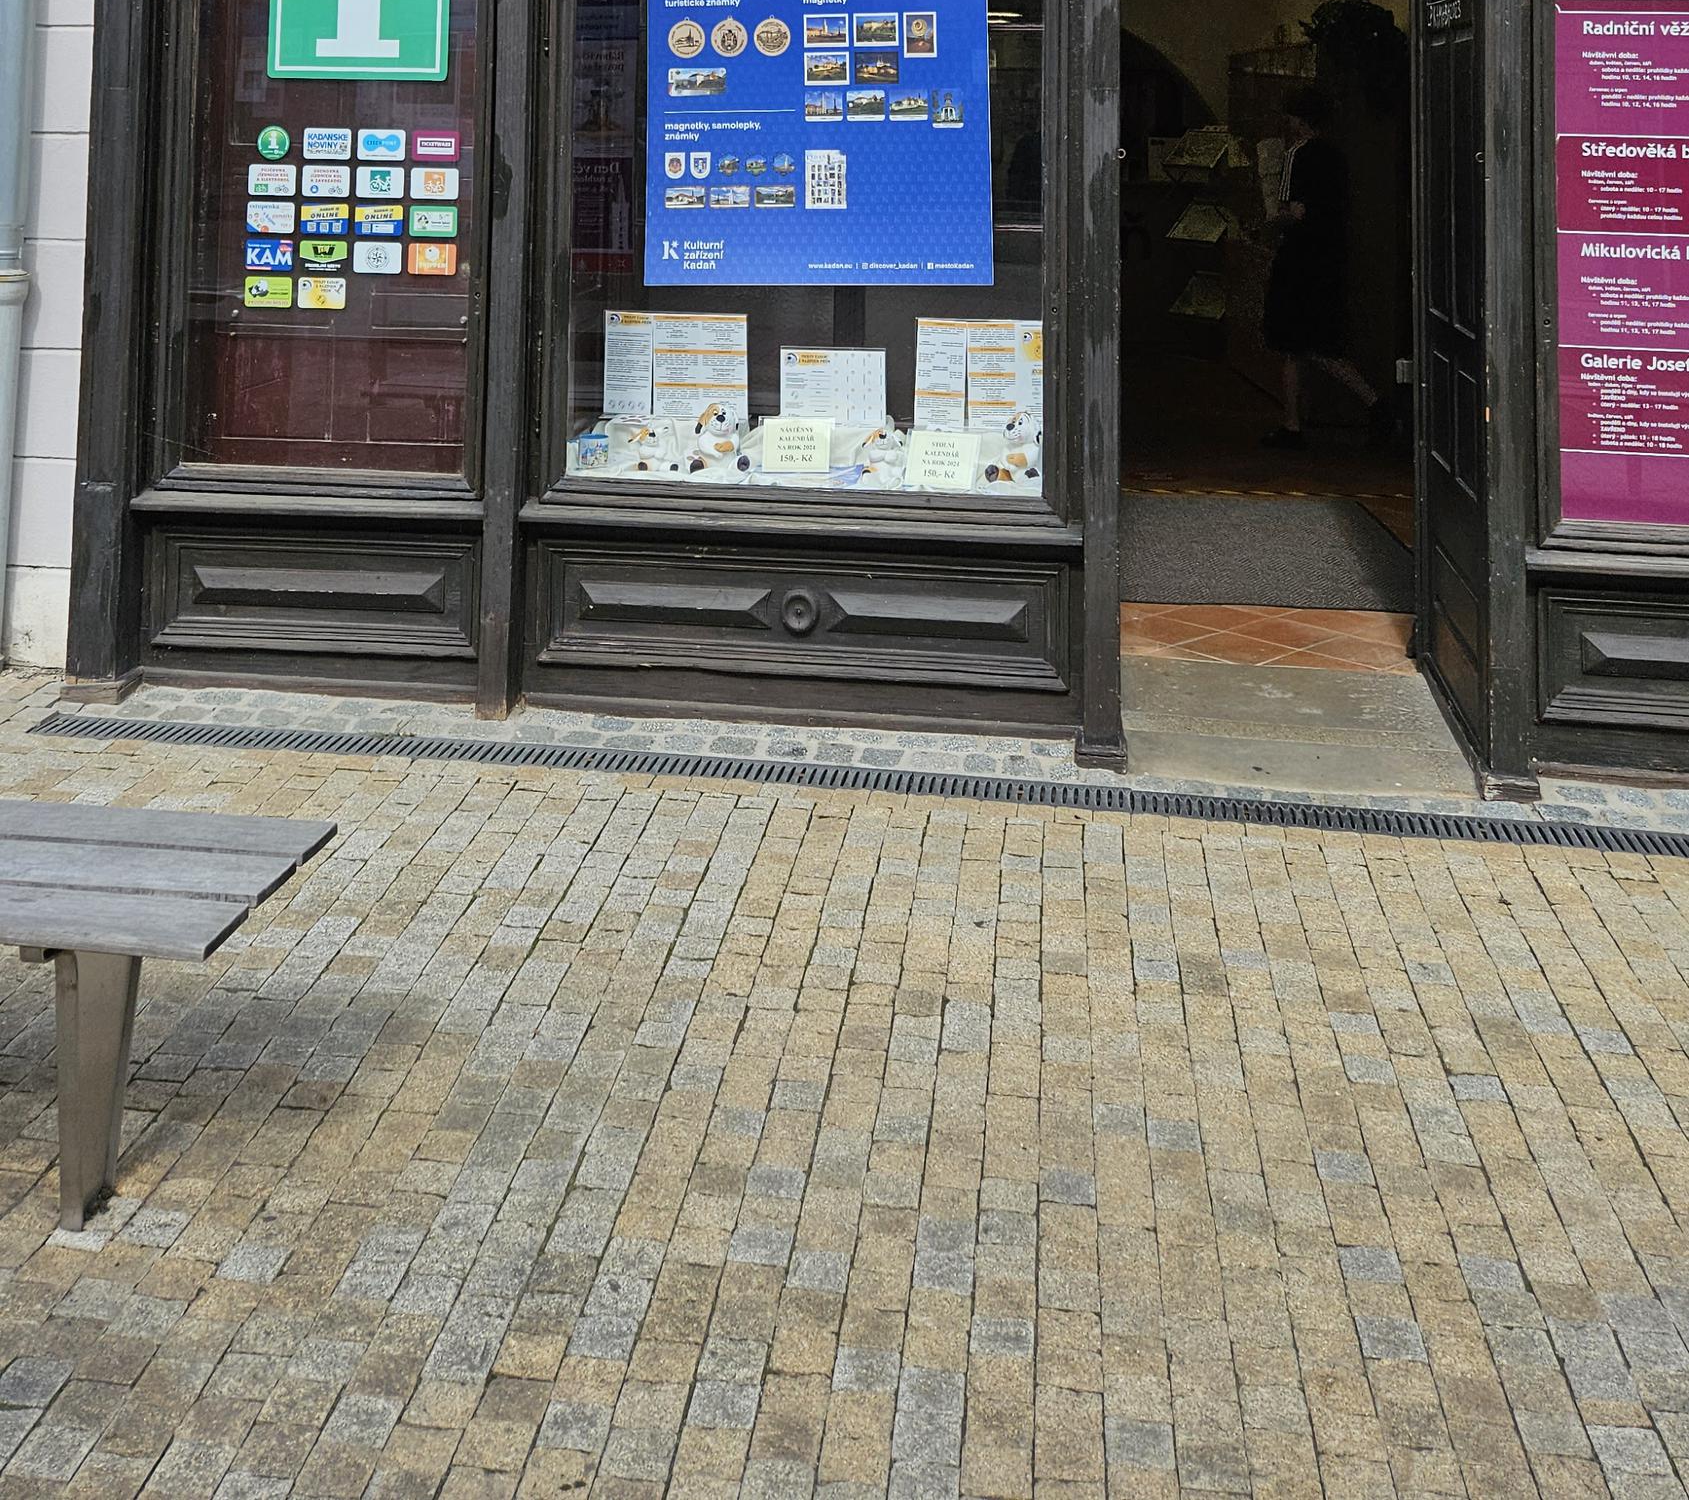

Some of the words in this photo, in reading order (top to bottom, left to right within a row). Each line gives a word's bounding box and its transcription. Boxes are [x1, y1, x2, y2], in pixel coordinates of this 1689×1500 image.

[665, 0, 704, 8] turistické
[1583, 20, 1655, 35] Radniční
[665, 122, 710, 131] magnetky,
[712, 121, 761, 130] samolepky,
[665, 133, 699, 142] známky
[1582, 142, 1677, 158] Středověká
[684, 240, 724, 250] Kulturní
[684, 251, 724, 260] zařízení
[1581, 243, 1680, 260] Mikulovická
[247, 248, 292, 265] KAM
[683, 260, 716, 269] Kadaň
[1581, 276, 1616, 284] Návštěvní
[1581, 353, 1642, 369] Galerie
[1581, 373, 1615, 381] Návštěvní
[802, 454, 812, 462] Kč
[925, 450, 959, 458] KALENDÁŘ
[924, 469, 942, 478] 150,-
[944, 470, 955, 478] Kč
